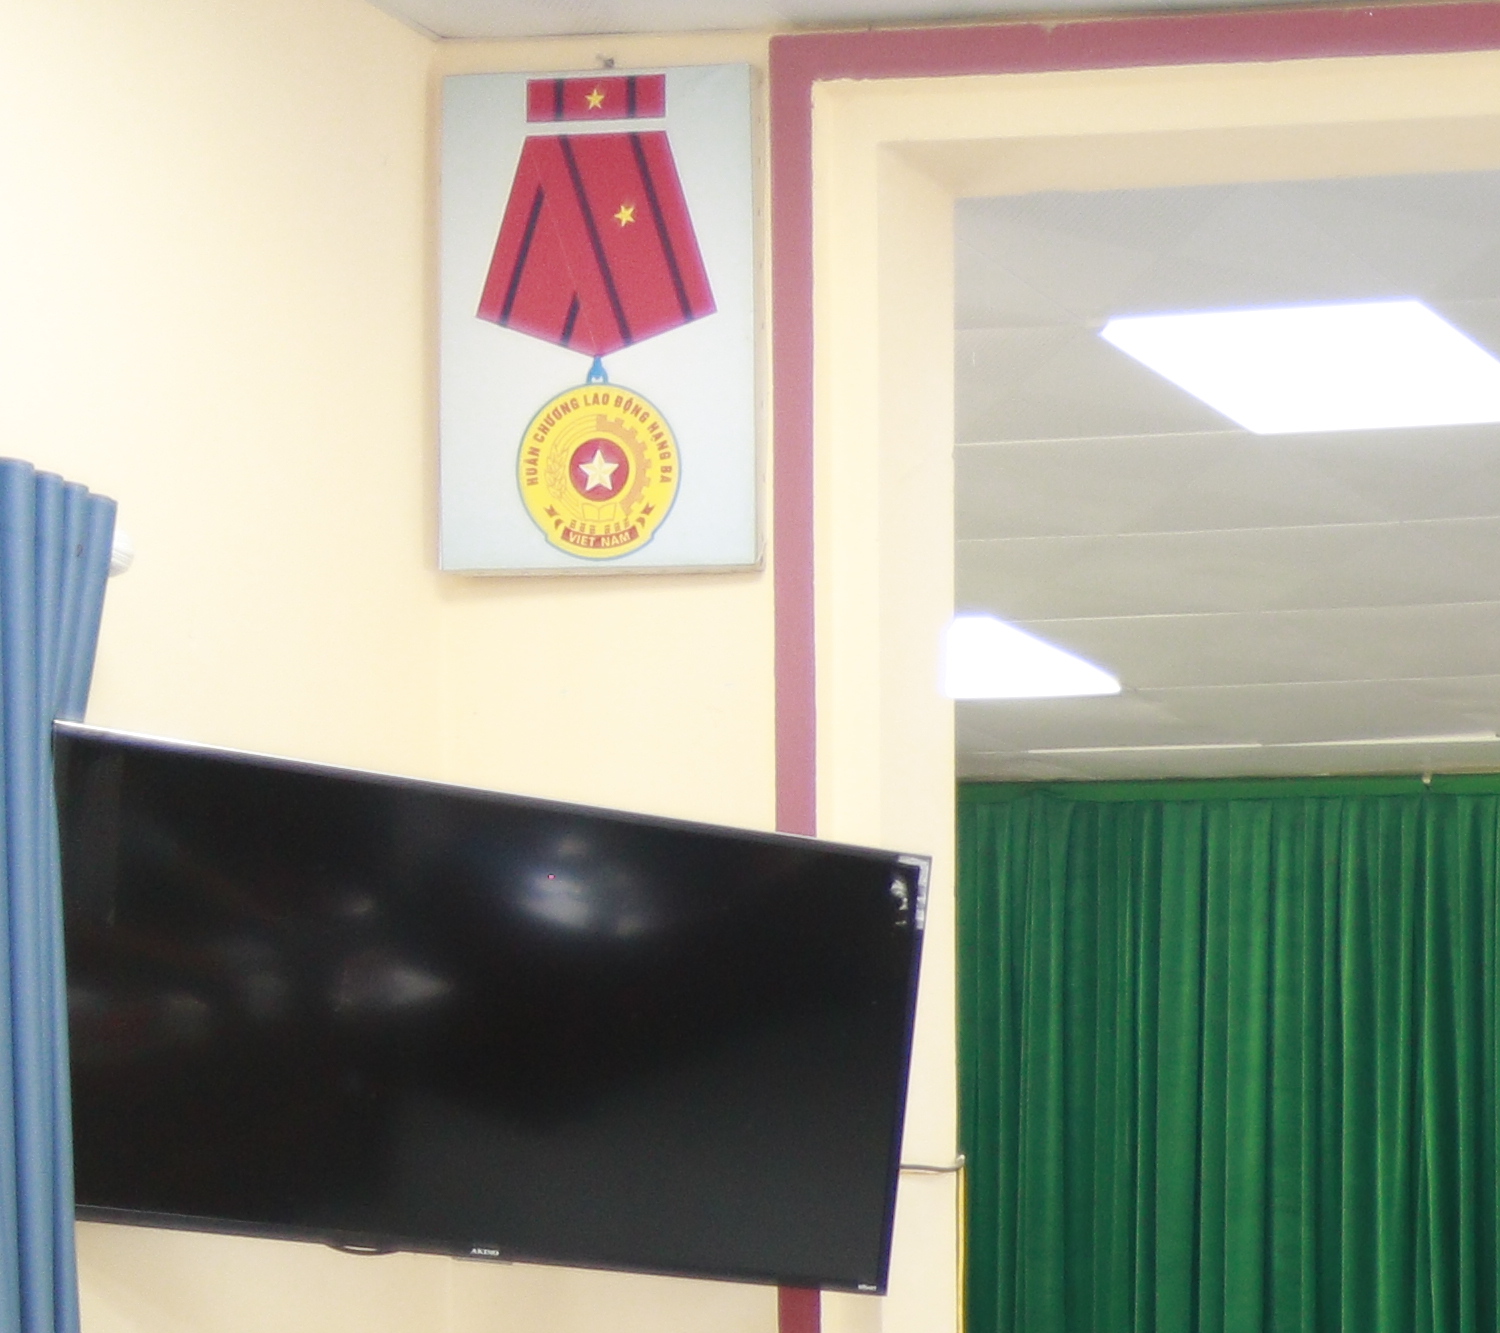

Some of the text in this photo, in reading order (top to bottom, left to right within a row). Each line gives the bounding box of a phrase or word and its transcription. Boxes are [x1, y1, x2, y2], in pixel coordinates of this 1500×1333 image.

[523, 446, 540, 486] HUÂN
[534, 398, 580, 442] CHƯƠNG
[584, 393, 610, 406] LAO
[614, 395, 650, 423] ĐỘNG
[660, 466, 672, 483] BA
[601, 532, 630, 546] NAM
